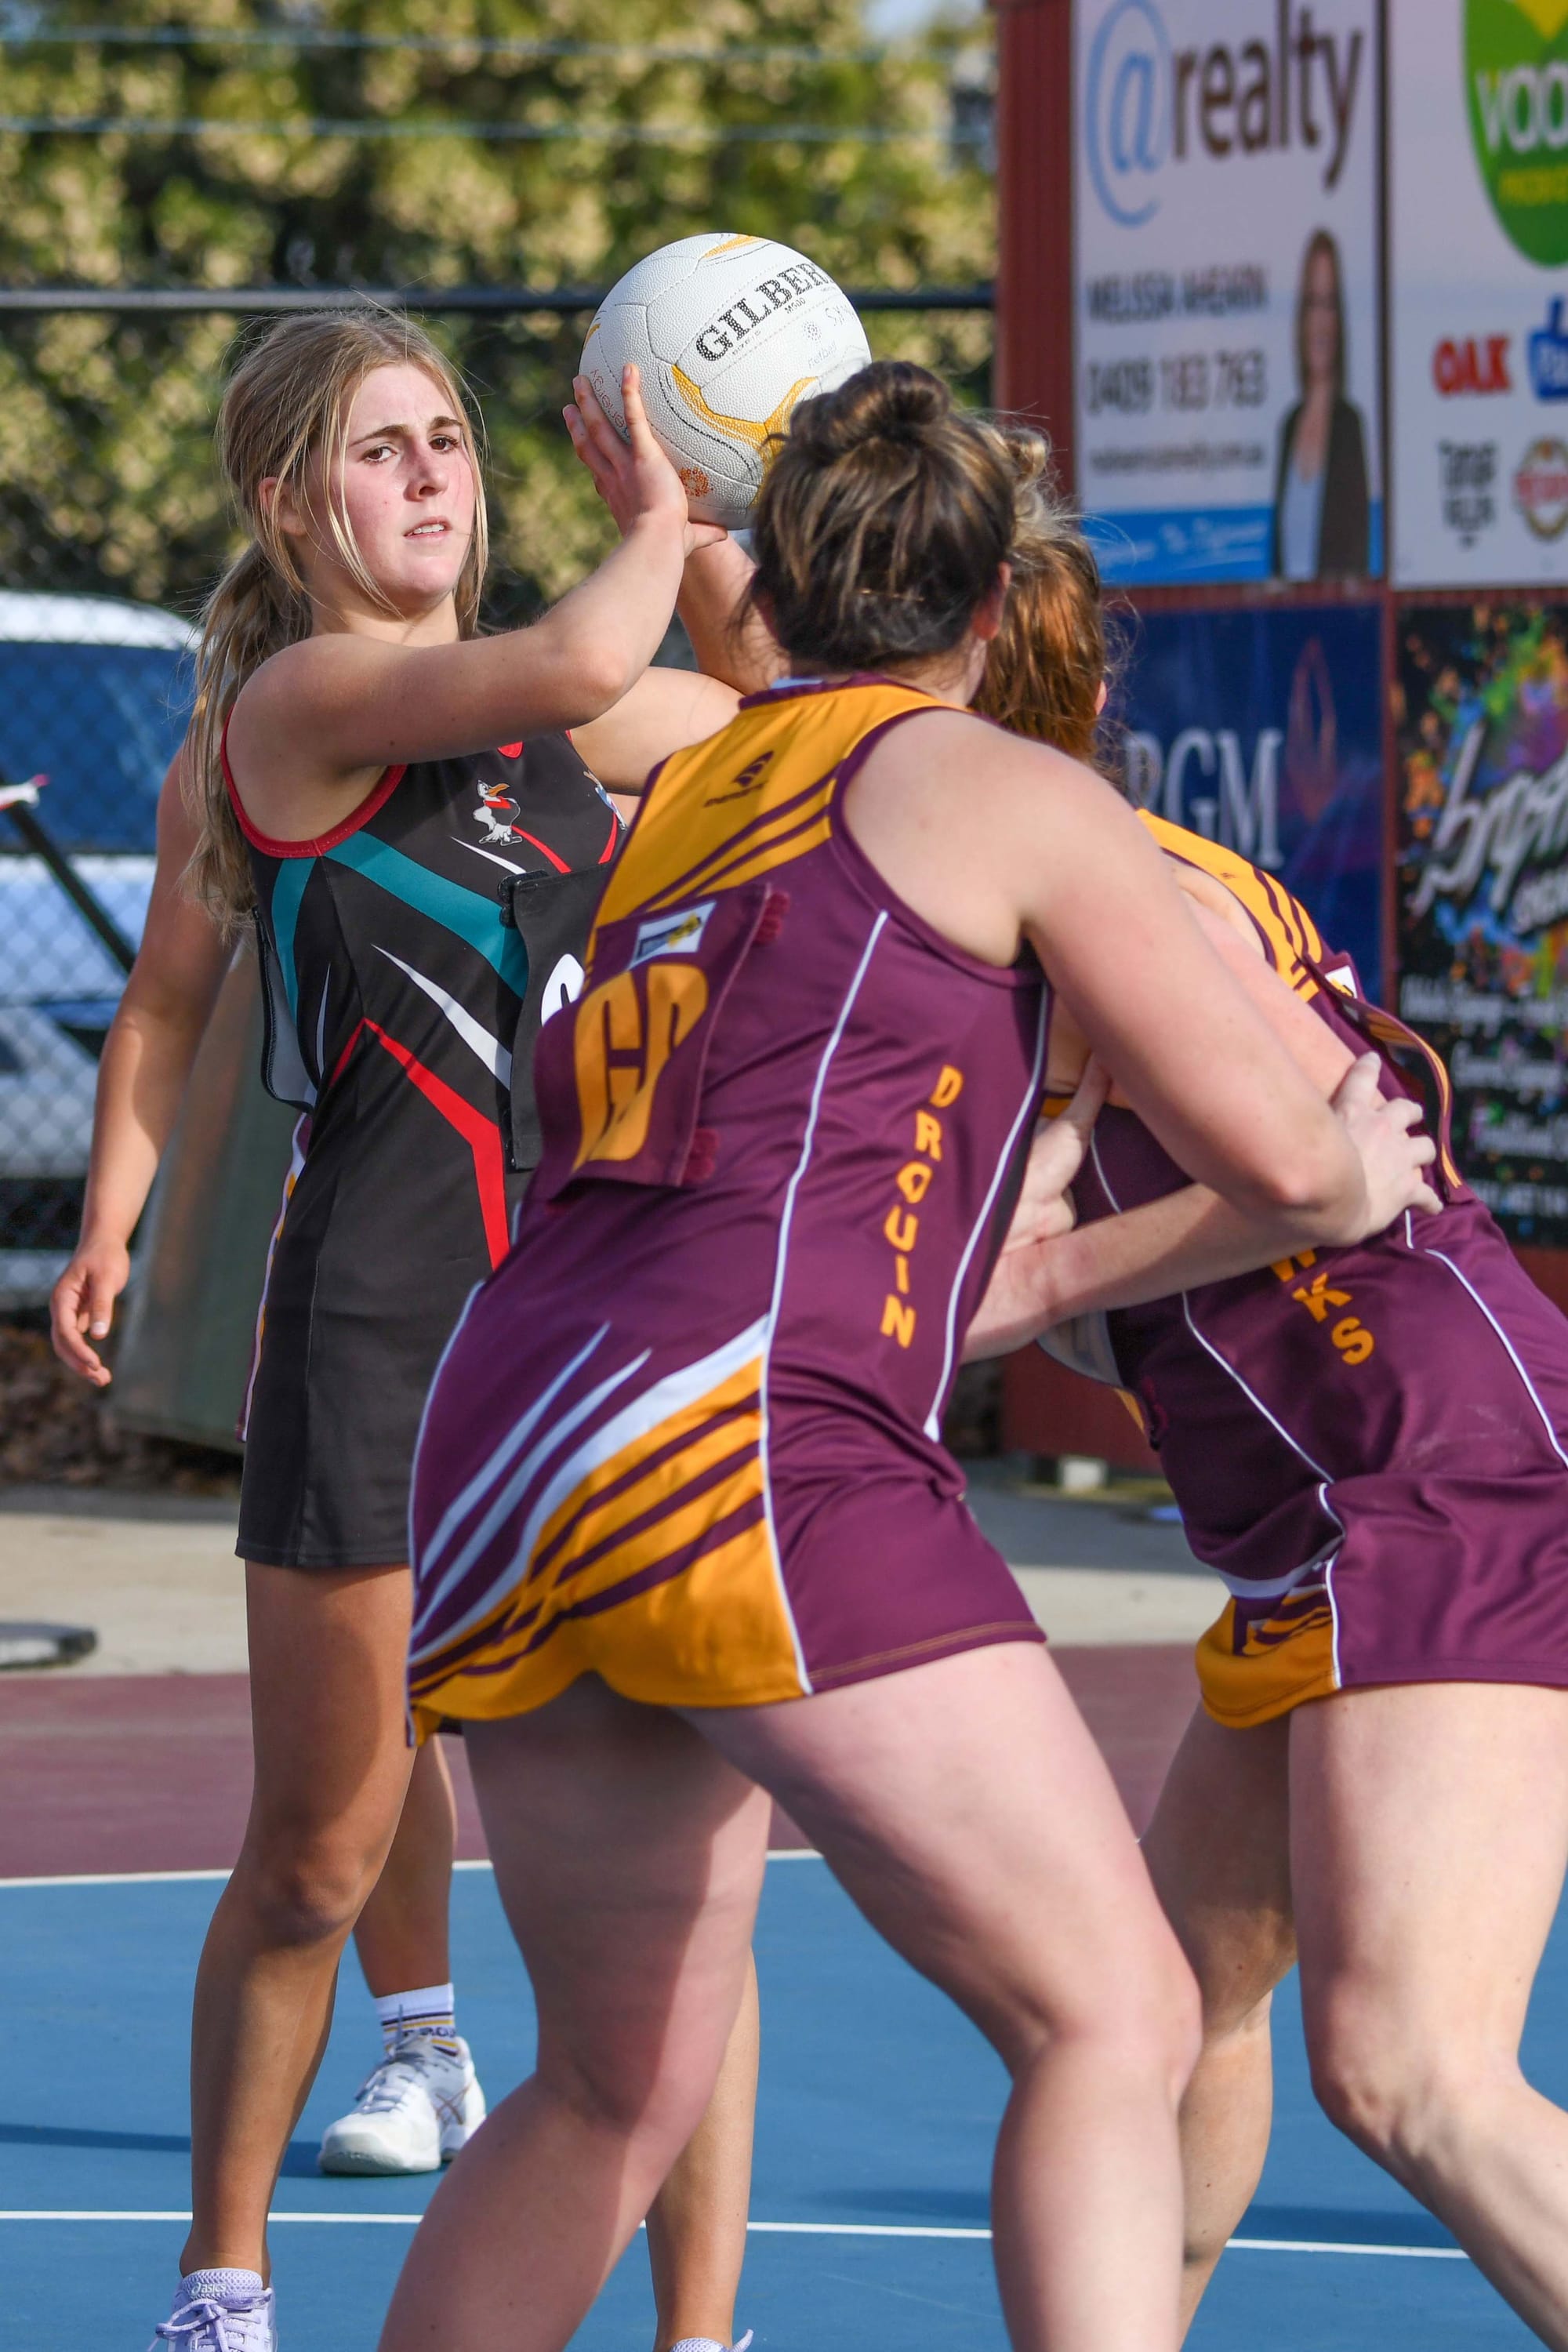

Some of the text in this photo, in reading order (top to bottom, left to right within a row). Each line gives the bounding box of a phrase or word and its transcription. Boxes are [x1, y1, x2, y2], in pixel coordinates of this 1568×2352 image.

[695, 263, 834, 361] GILBER
[1433, 335, 1510, 398] OAK
[880, 1065, 964, 1349] DROUIN
